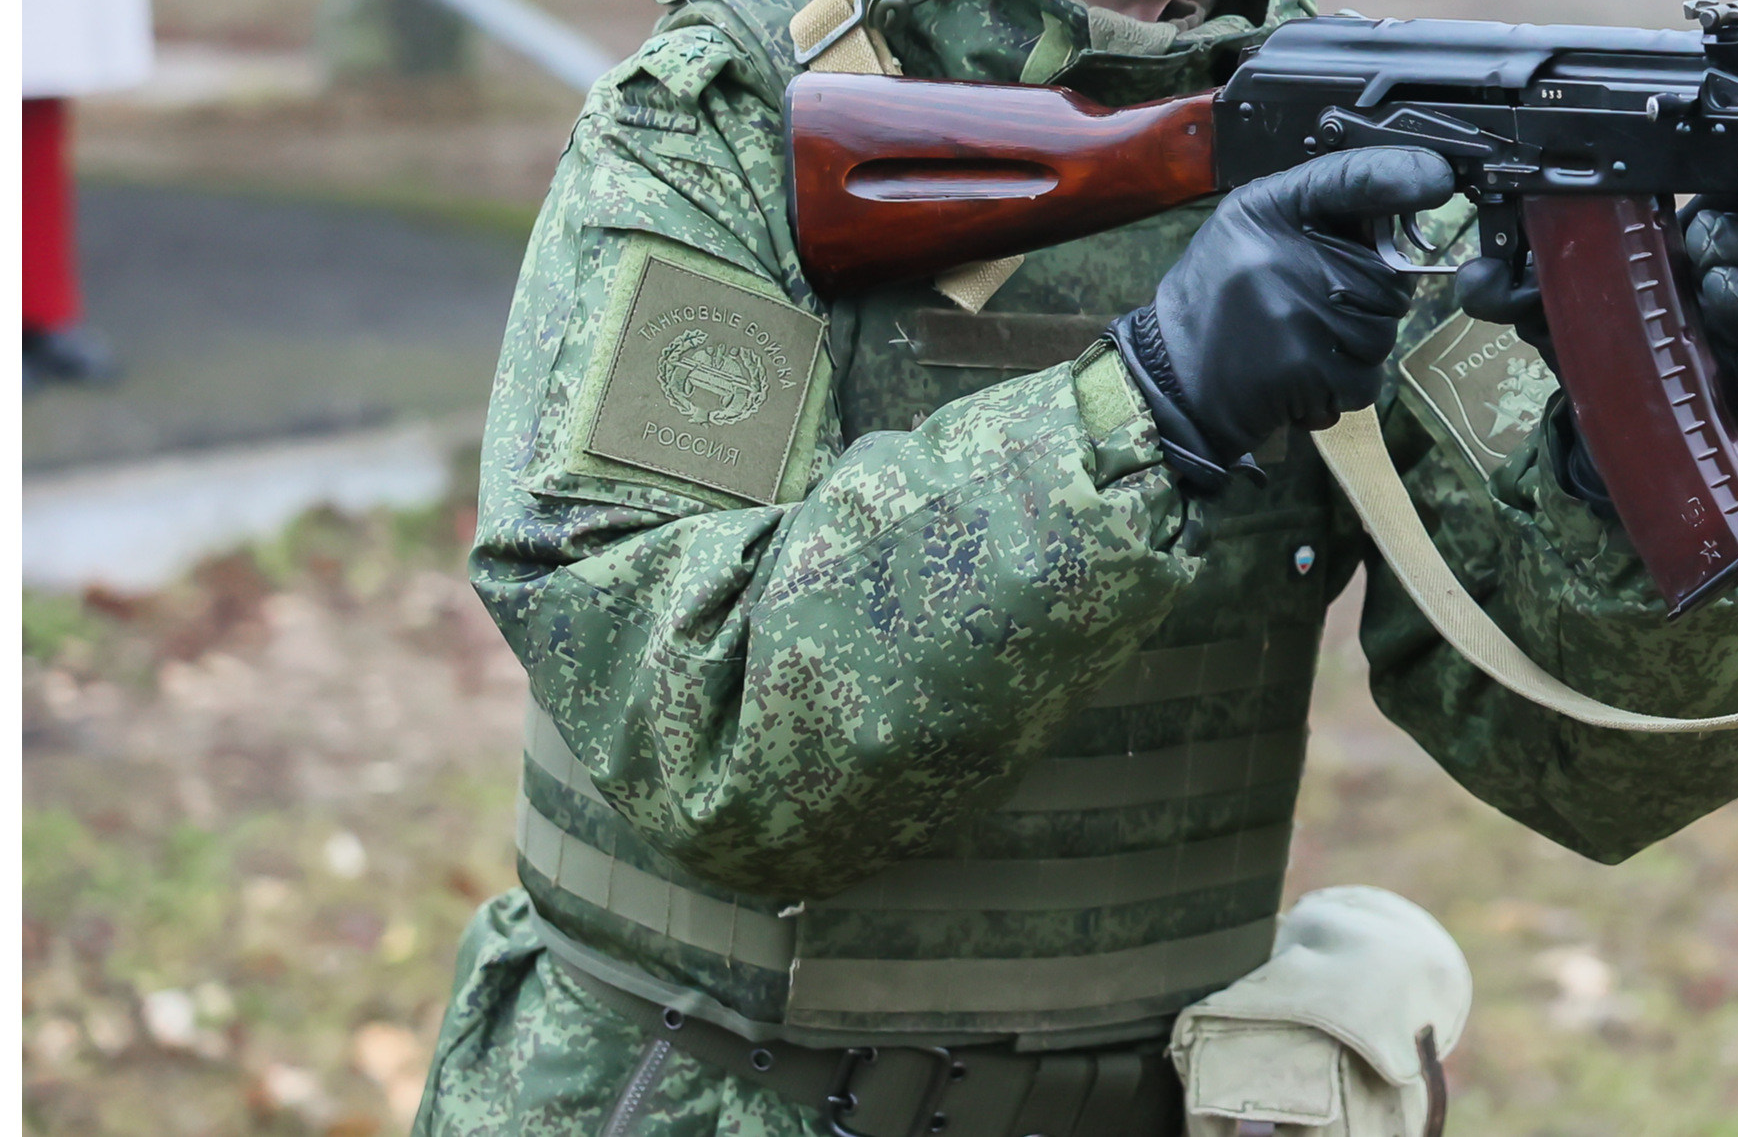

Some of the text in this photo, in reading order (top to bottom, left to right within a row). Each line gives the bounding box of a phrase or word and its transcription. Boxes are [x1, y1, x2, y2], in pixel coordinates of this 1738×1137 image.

[638, 305, 797, 390] ТАНКОВЫЕ ВОЙСКА
[642, 421, 741, 466] РОССИЯ
